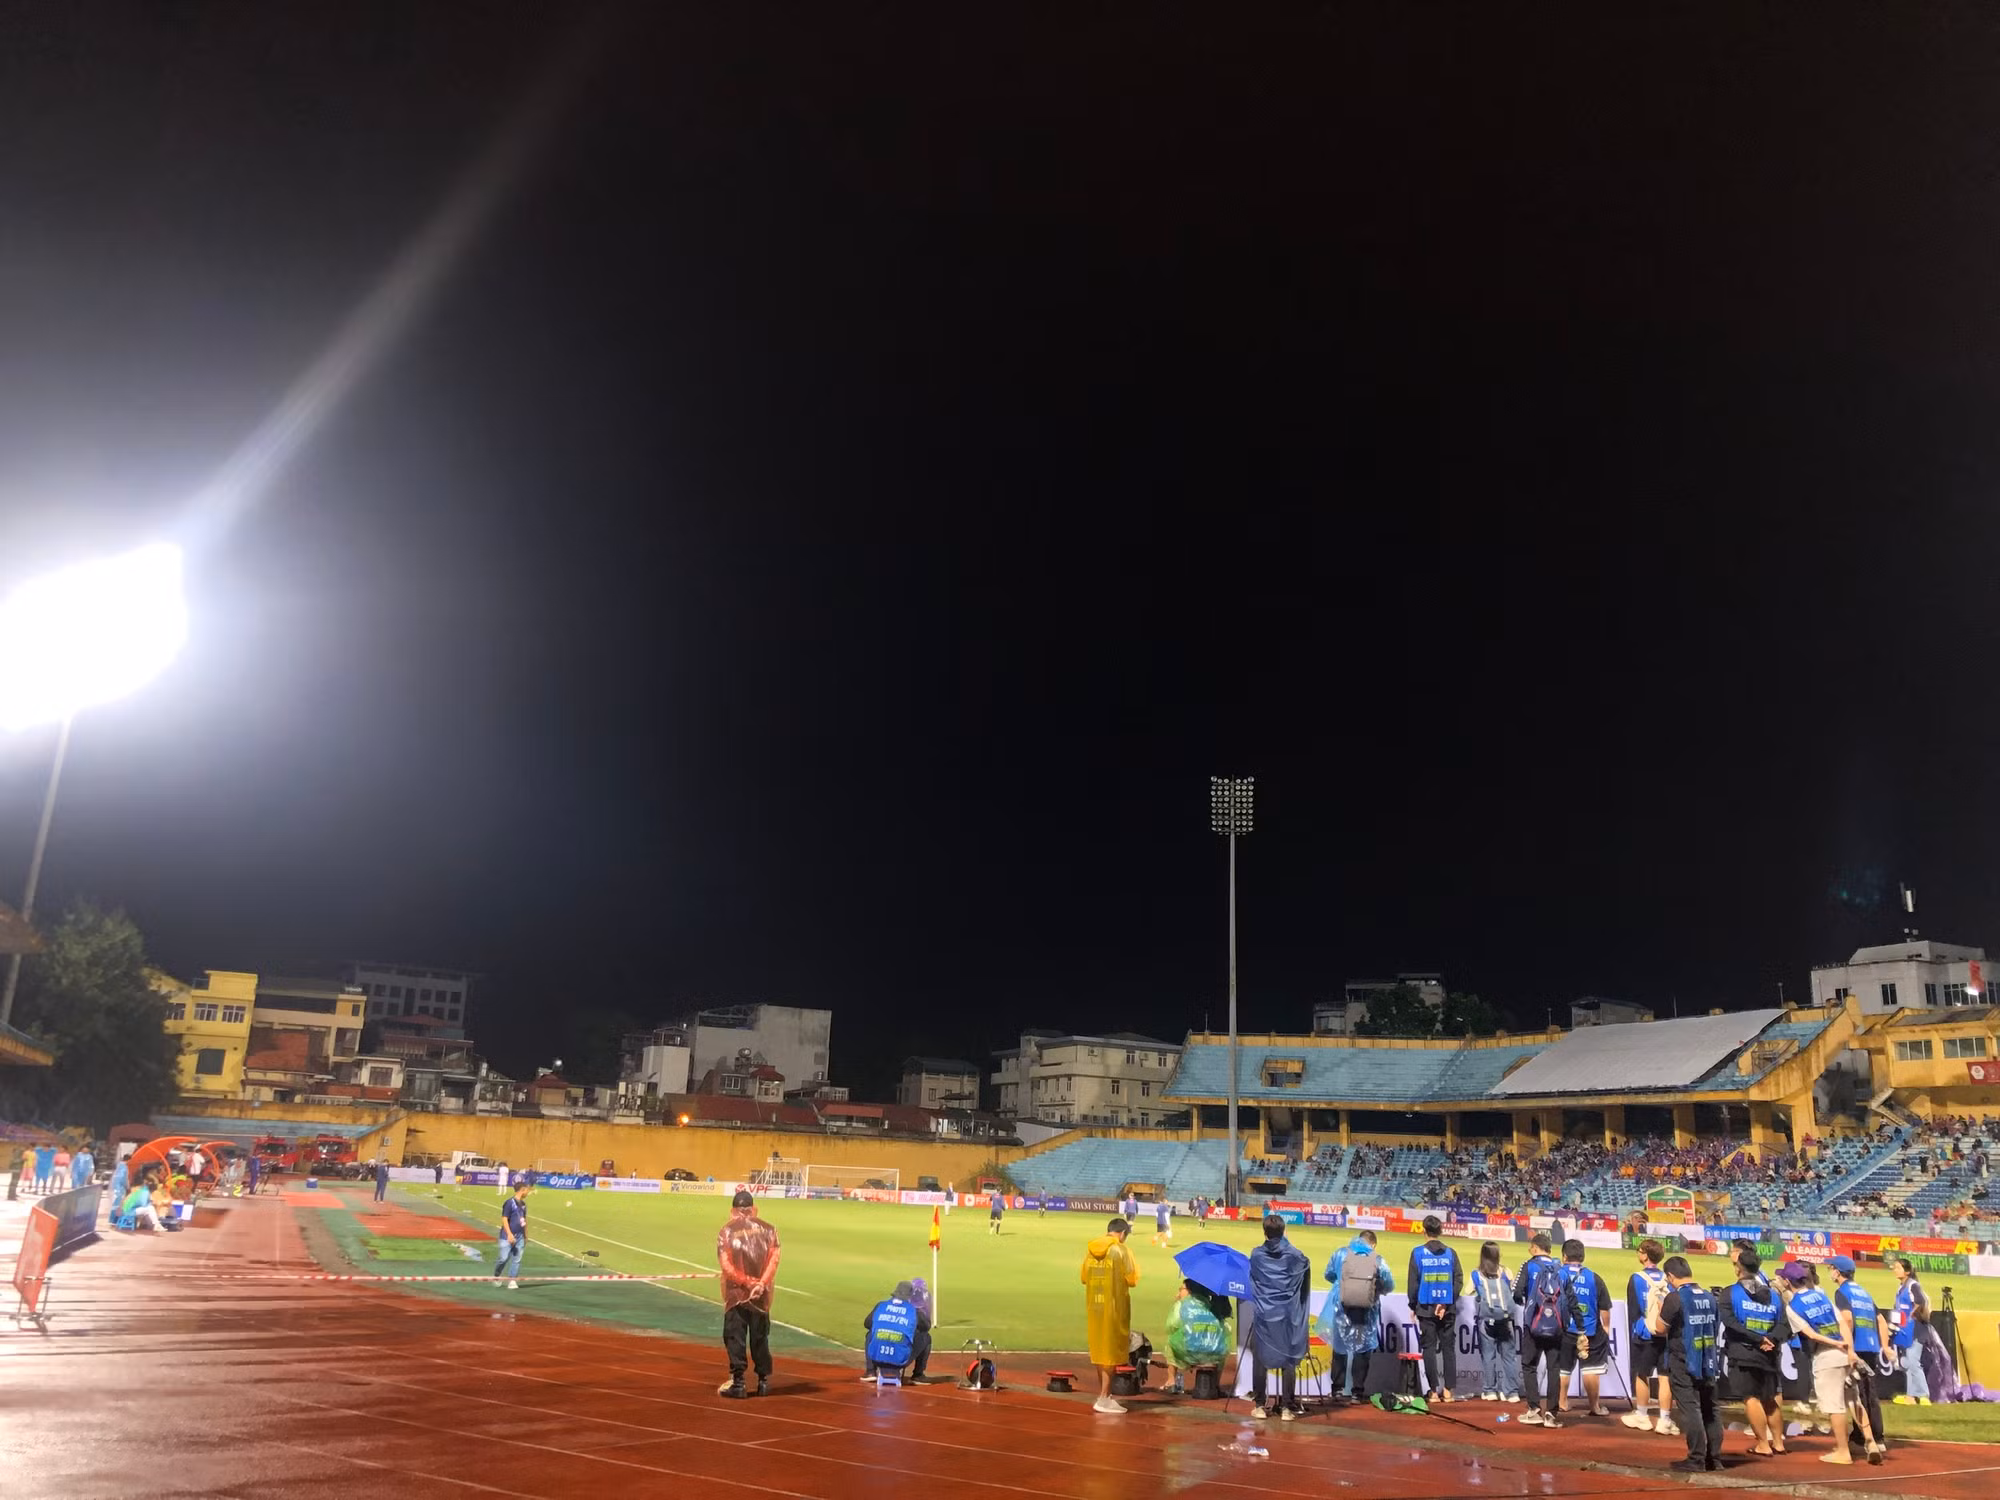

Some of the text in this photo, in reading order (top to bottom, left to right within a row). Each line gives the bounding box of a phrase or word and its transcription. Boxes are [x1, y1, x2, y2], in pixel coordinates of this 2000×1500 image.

[549, 1175, 579, 1188] Opal
[748, 1184, 773, 1195] VPF
[975, 1197, 990, 1206] FPT
[1069, 1201, 1091, 1211] ADAM
[1093, 1202, 1117, 1212] STORE
[1877, 1237, 1901, 1251] K5
[1954, 1241, 1979, 1254] K5
[1784, 1245, 1830, 1257] V.LEAGUE
[1929, 1256, 1955, 1270] WOLF
[886, 1304, 907, 1315] PHOTO
[878, 1313, 909, 1327] 2023/24
[880, 1345, 895, 1356] 335
